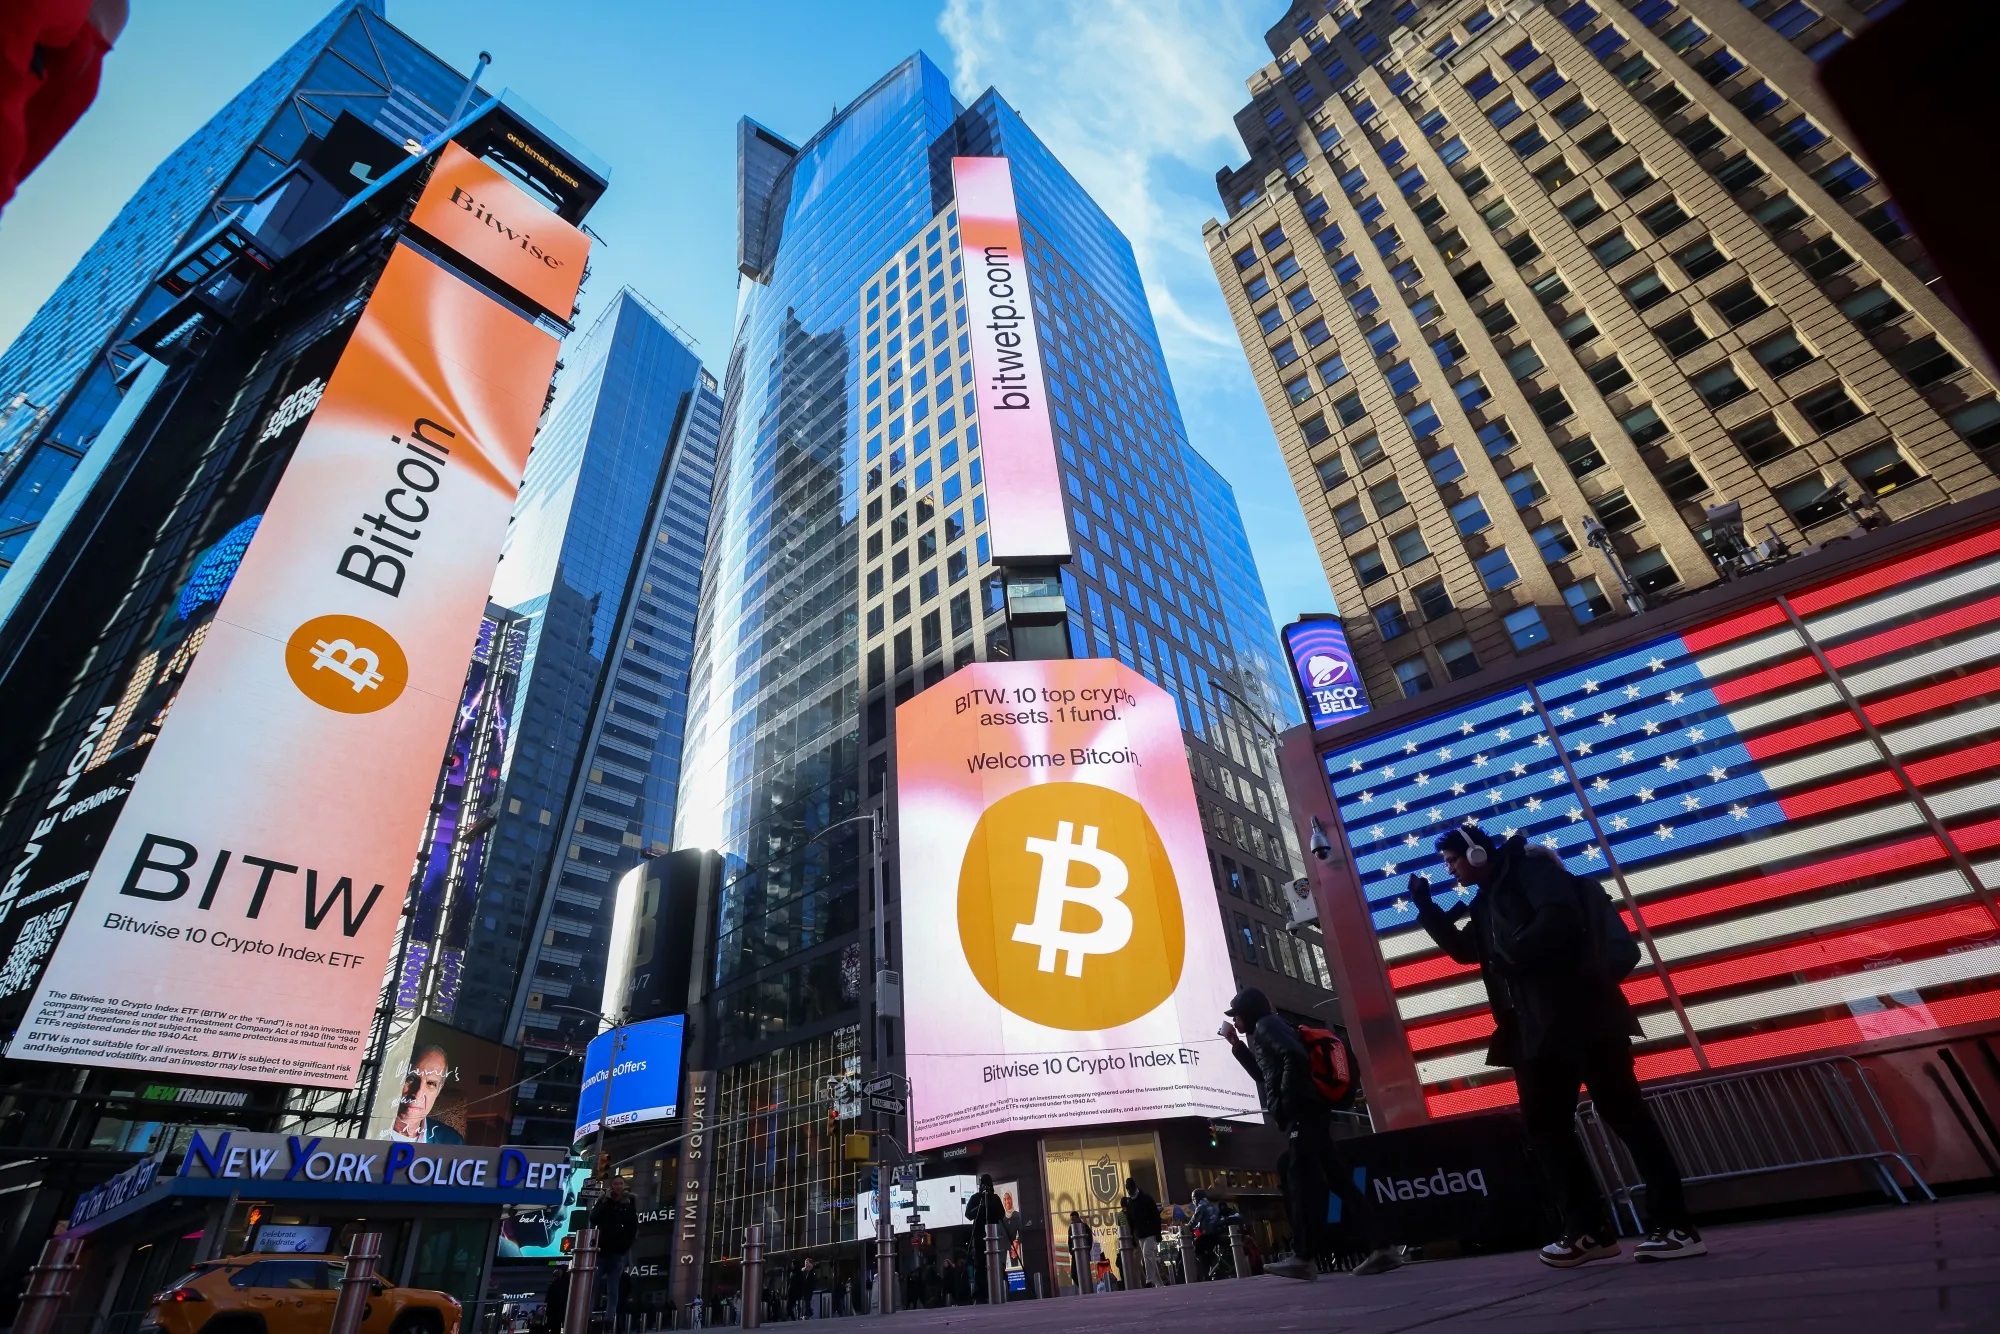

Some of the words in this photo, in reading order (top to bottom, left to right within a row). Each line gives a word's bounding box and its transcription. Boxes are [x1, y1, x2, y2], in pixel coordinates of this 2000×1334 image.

[507, 132, 525, 149] one
[524, 143, 550, 168] times
[548, 162, 579, 188] square
[984, 246, 1030, 409] bitwetp.com
[279, 377, 321, 411] one
[260, 393, 323, 443] squar
[336, 417, 456, 598] Bitcoin
[955, 688, 1009, 715] BITW.
[1013, 687, 1036, 704] 10
[1041, 687, 1075, 705] top
[1080, 688, 1136, 707] crypto
[1312, 686, 1357, 703] TACO
[1319, 699, 1362, 715] BELL
[980, 708, 1053, 726] assets.
[1057, 707, 1065, 722] 1
[1070, 705, 1122, 722] fund.
[46, 706, 116, 809] NOW
[967, 751, 1065, 774] Welcome
[119, 833, 385, 938] BITW
[103, 913, 180, 939] Bitwise
[184, 927, 207, 943] 10
[211, 932, 274, 955] Crypto
[277, 943, 327, 964] Index
[328, 952, 365, 969] ETF
[34, 1018, 61, 1027] ETFs
[62, 1021, 112, 1032] registered
[113, 1026, 141, 1035] under
[142, 1029, 157, 1037] the
[158, 1031, 181, 1040] 1940
[181, 1033, 198, 1041] Act.
[43, 1000, 89, 1011] company
[91, 1005, 139, 1017] registered
[141, 1012, 168, 1020] under
[169, 1014, 184, 1023] the
[186, 1017, 237, 1029] Investment
[235, 1023, 273, 1034] Company
[275, 1027, 289, 1035] Act
[301, 1030, 319, 1039] 1940
[321, 1032, 336, 1041] (the
[48, 990, 67, 999] The
[69, 993, 105, 1004] Bitwise
[107, 998, 118, 1006] 10
[121, 1000, 153, 1011] Crypto
[154, 1004, 179, 1013] Index
[181, 1007, 199, 1015] ETF
[286, 1020, 293, 1028] is
[295, 1022, 308, 1030] not
[321, 1025, 361, 1036] investment
[66, 1012, 85, 1020] and
[87, 1015, 131, 1025] therefore
[159, 1022, 192, 1034] subject
[203, 1027, 217, 1035] the
[219, 1030, 241, 1038] same
[242, 1033, 288, 1043] protections
[299, 1039, 327, 1048] mutual
[326, 1040, 348, 1051] funds
[23, 1042, 45, 1052] and
[46, 1045, 105, 1057] heightened
[105, 1051, 148, 1063] volatility,
[148, 1055, 167, 1063] and
[168, 1057, 180, 1065] an
[181, 1059, 219, 1068] investor
[219, 1063, 238, 1071] may
[239, 1064, 257, 1072] lose
[258, 1066, 278, 1074] their
[303, 1070, 349, 1081] investment.
[28, 1032, 59, 1042] BITW
[60, 1035, 70, 1043] is
[72, 1037, 90, 1045] not
[92, 1038, 133, 1049] suitable
[135, 1043, 150, 1051] for
[164, 1045, 210, 1058] investors.
[212, 1050, 238, 1060] BITW
[239, 1053, 247, 1061] is
[248, 1055, 282, 1066] subject
[282, 1057, 291, 1065] to
[292, 1060, 336, 1071] significant
[336, 1064, 351, 1072] risk
[982, 1060, 1039, 1083] Bitwise
[1042, 1058, 1062, 1075] 10
[1066, 1056, 1126, 1075] Crypto
[1129, 1051, 1176, 1068] Index
[1179, 1048, 1199, 1066] ETF
[606, 1114, 630, 1125] CHASE
[689, 1085, 706, 1159] SQUARE
[178, 1129, 280, 1178] NEW
[283, 1135, 378, 1184] YORK
[383, 1142, 488, 1187] POLICE
[499, 1149, 572, 1189] DEPT
[944, 1147, 967, 1158] branded
[1373, 1167, 1488, 1203] Nasdaq
[519, 1215, 537, 1223] bad
[637, 1209, 675, 1223] CHASE
[683, 1180, 700, 1240] TIMES
[624, 1264, 658, 1276] HASE
[680, 1254, 694, 1264] 3
